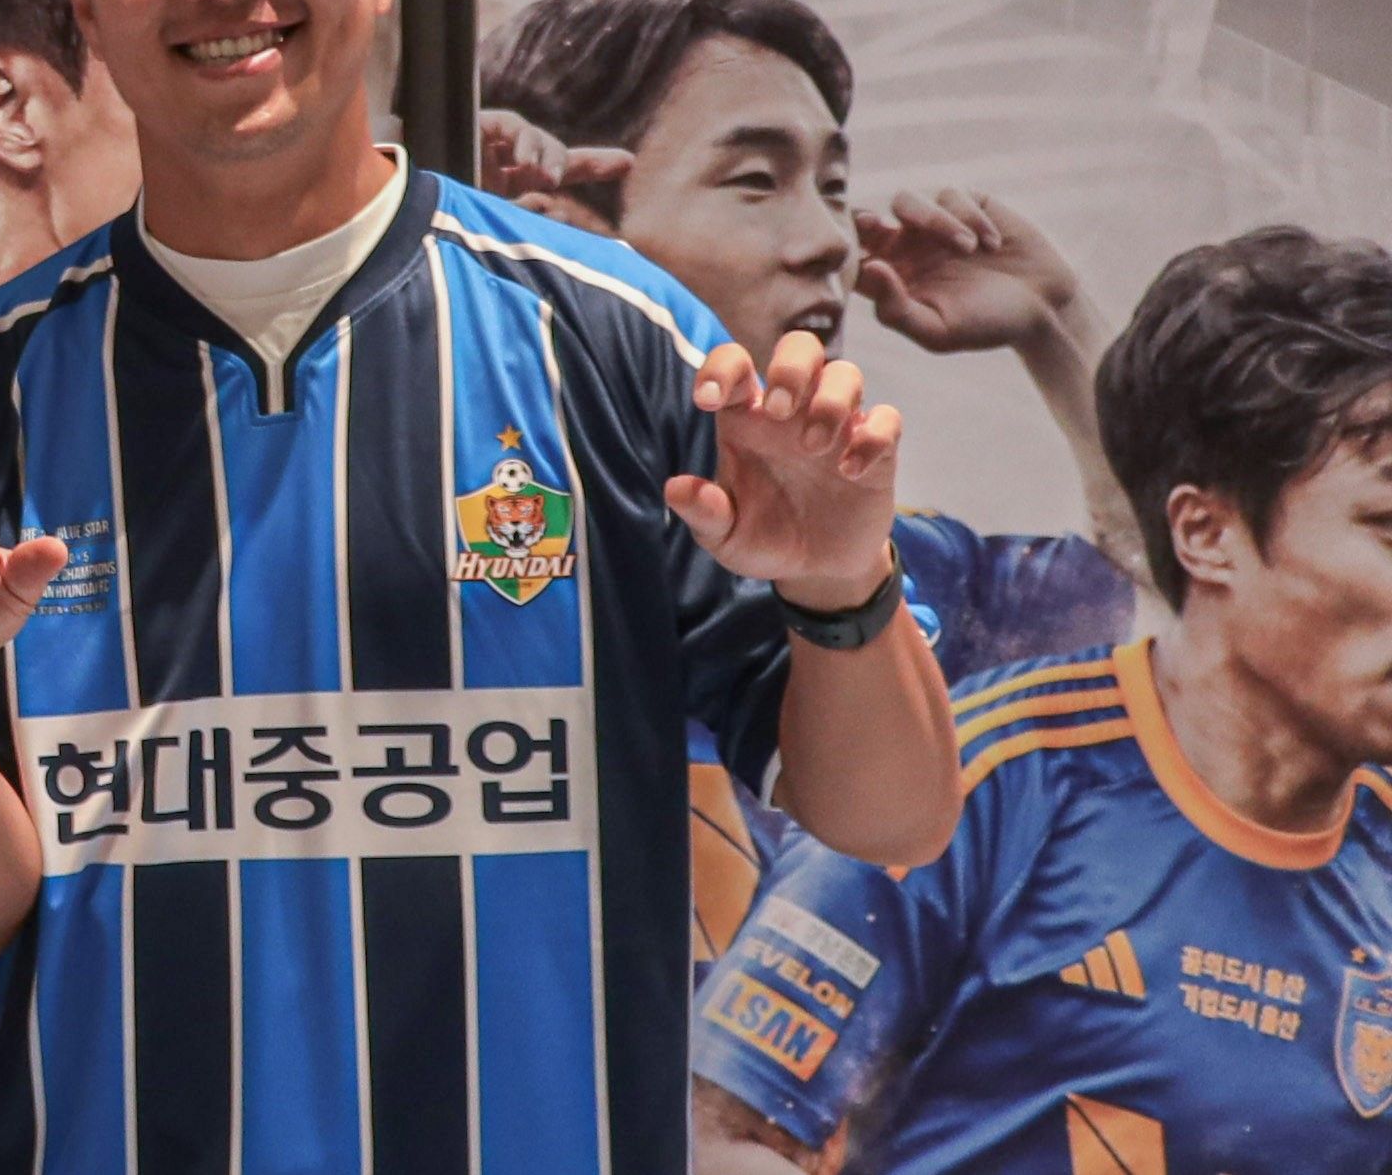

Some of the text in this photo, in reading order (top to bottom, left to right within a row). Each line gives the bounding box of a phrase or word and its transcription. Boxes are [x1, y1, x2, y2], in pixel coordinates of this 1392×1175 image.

[83, 520, 109, 537] STAR
[453, 552, 577, 581] HYUNDAI
[38, 718, 569, 846] 현대중공업
